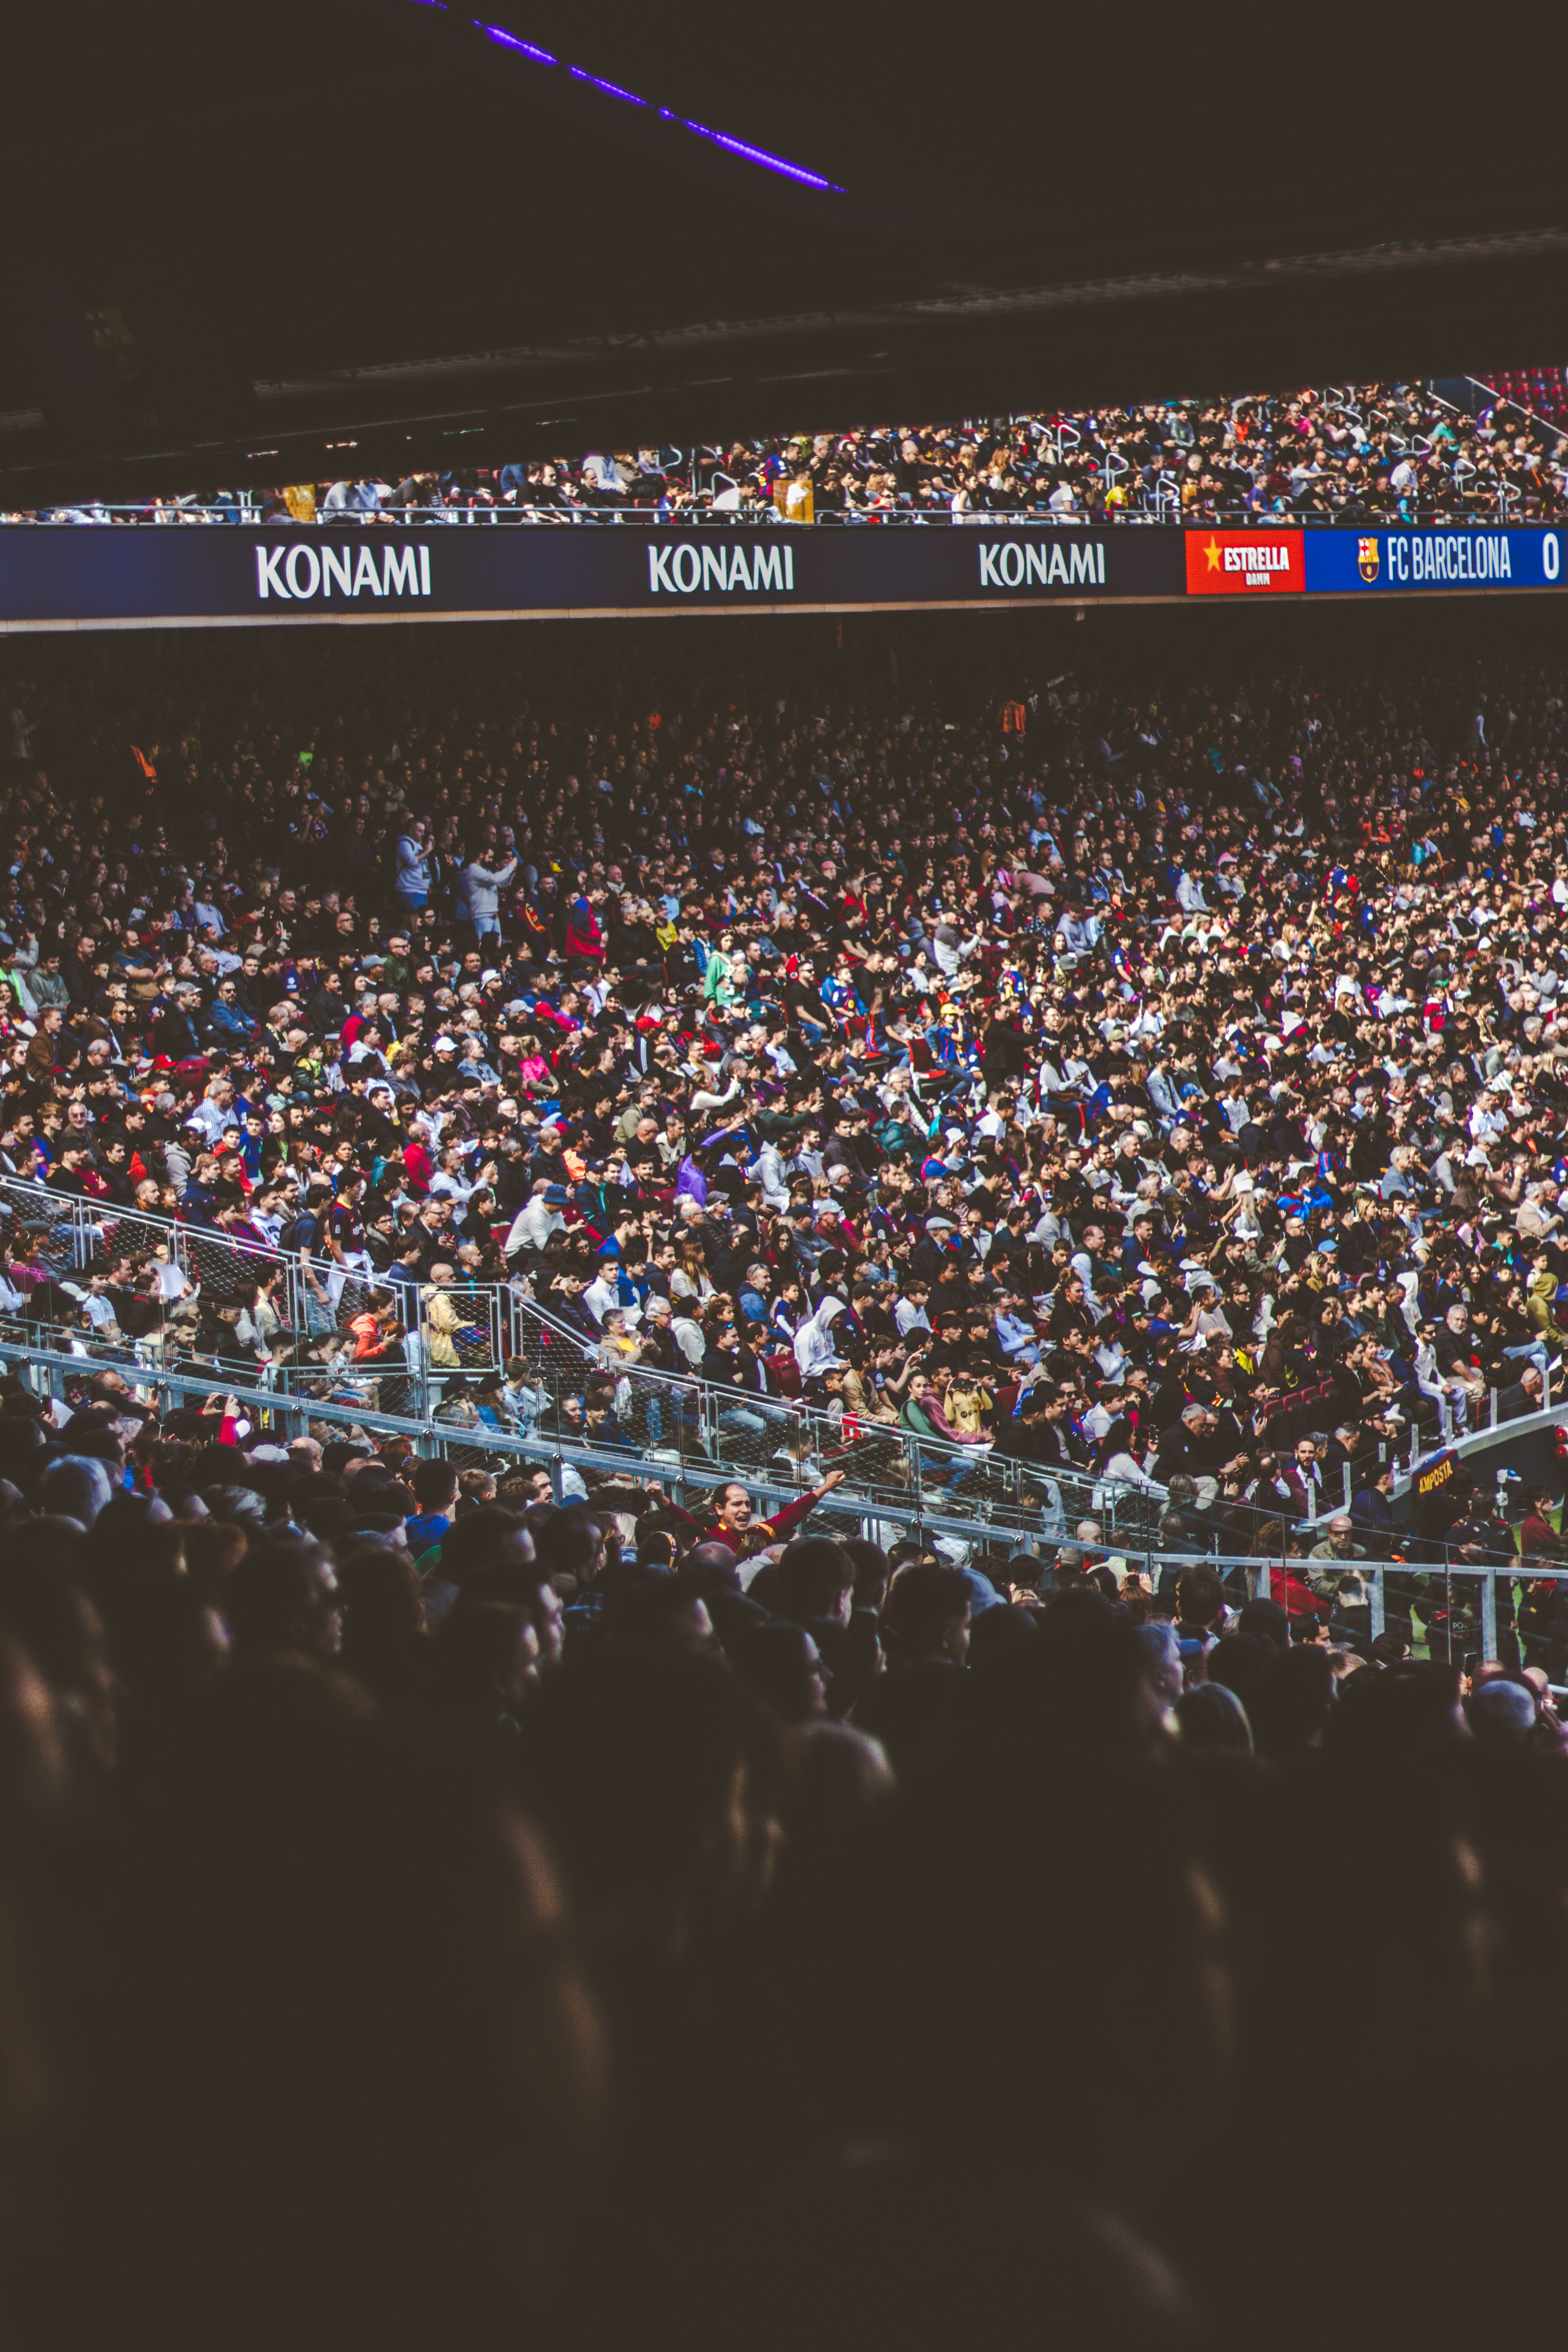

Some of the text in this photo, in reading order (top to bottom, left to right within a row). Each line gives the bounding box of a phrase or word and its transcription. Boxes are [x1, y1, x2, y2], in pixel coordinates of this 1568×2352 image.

[256, 544, 431, 599] KONAMI
[648, 544, 794, 593] KONAMI
[978, 543, 1105, 586] KONAMI
[1224, 546, 1290, 571] ESTRELLA
[1387, 536, 1512, 581] FC BARCELONA
[1543, 532, 1560, 580] 0
[1245, 572, 1270, 586] DAMM
[1419, 1459, 1453, 1494] AMPOSTA
